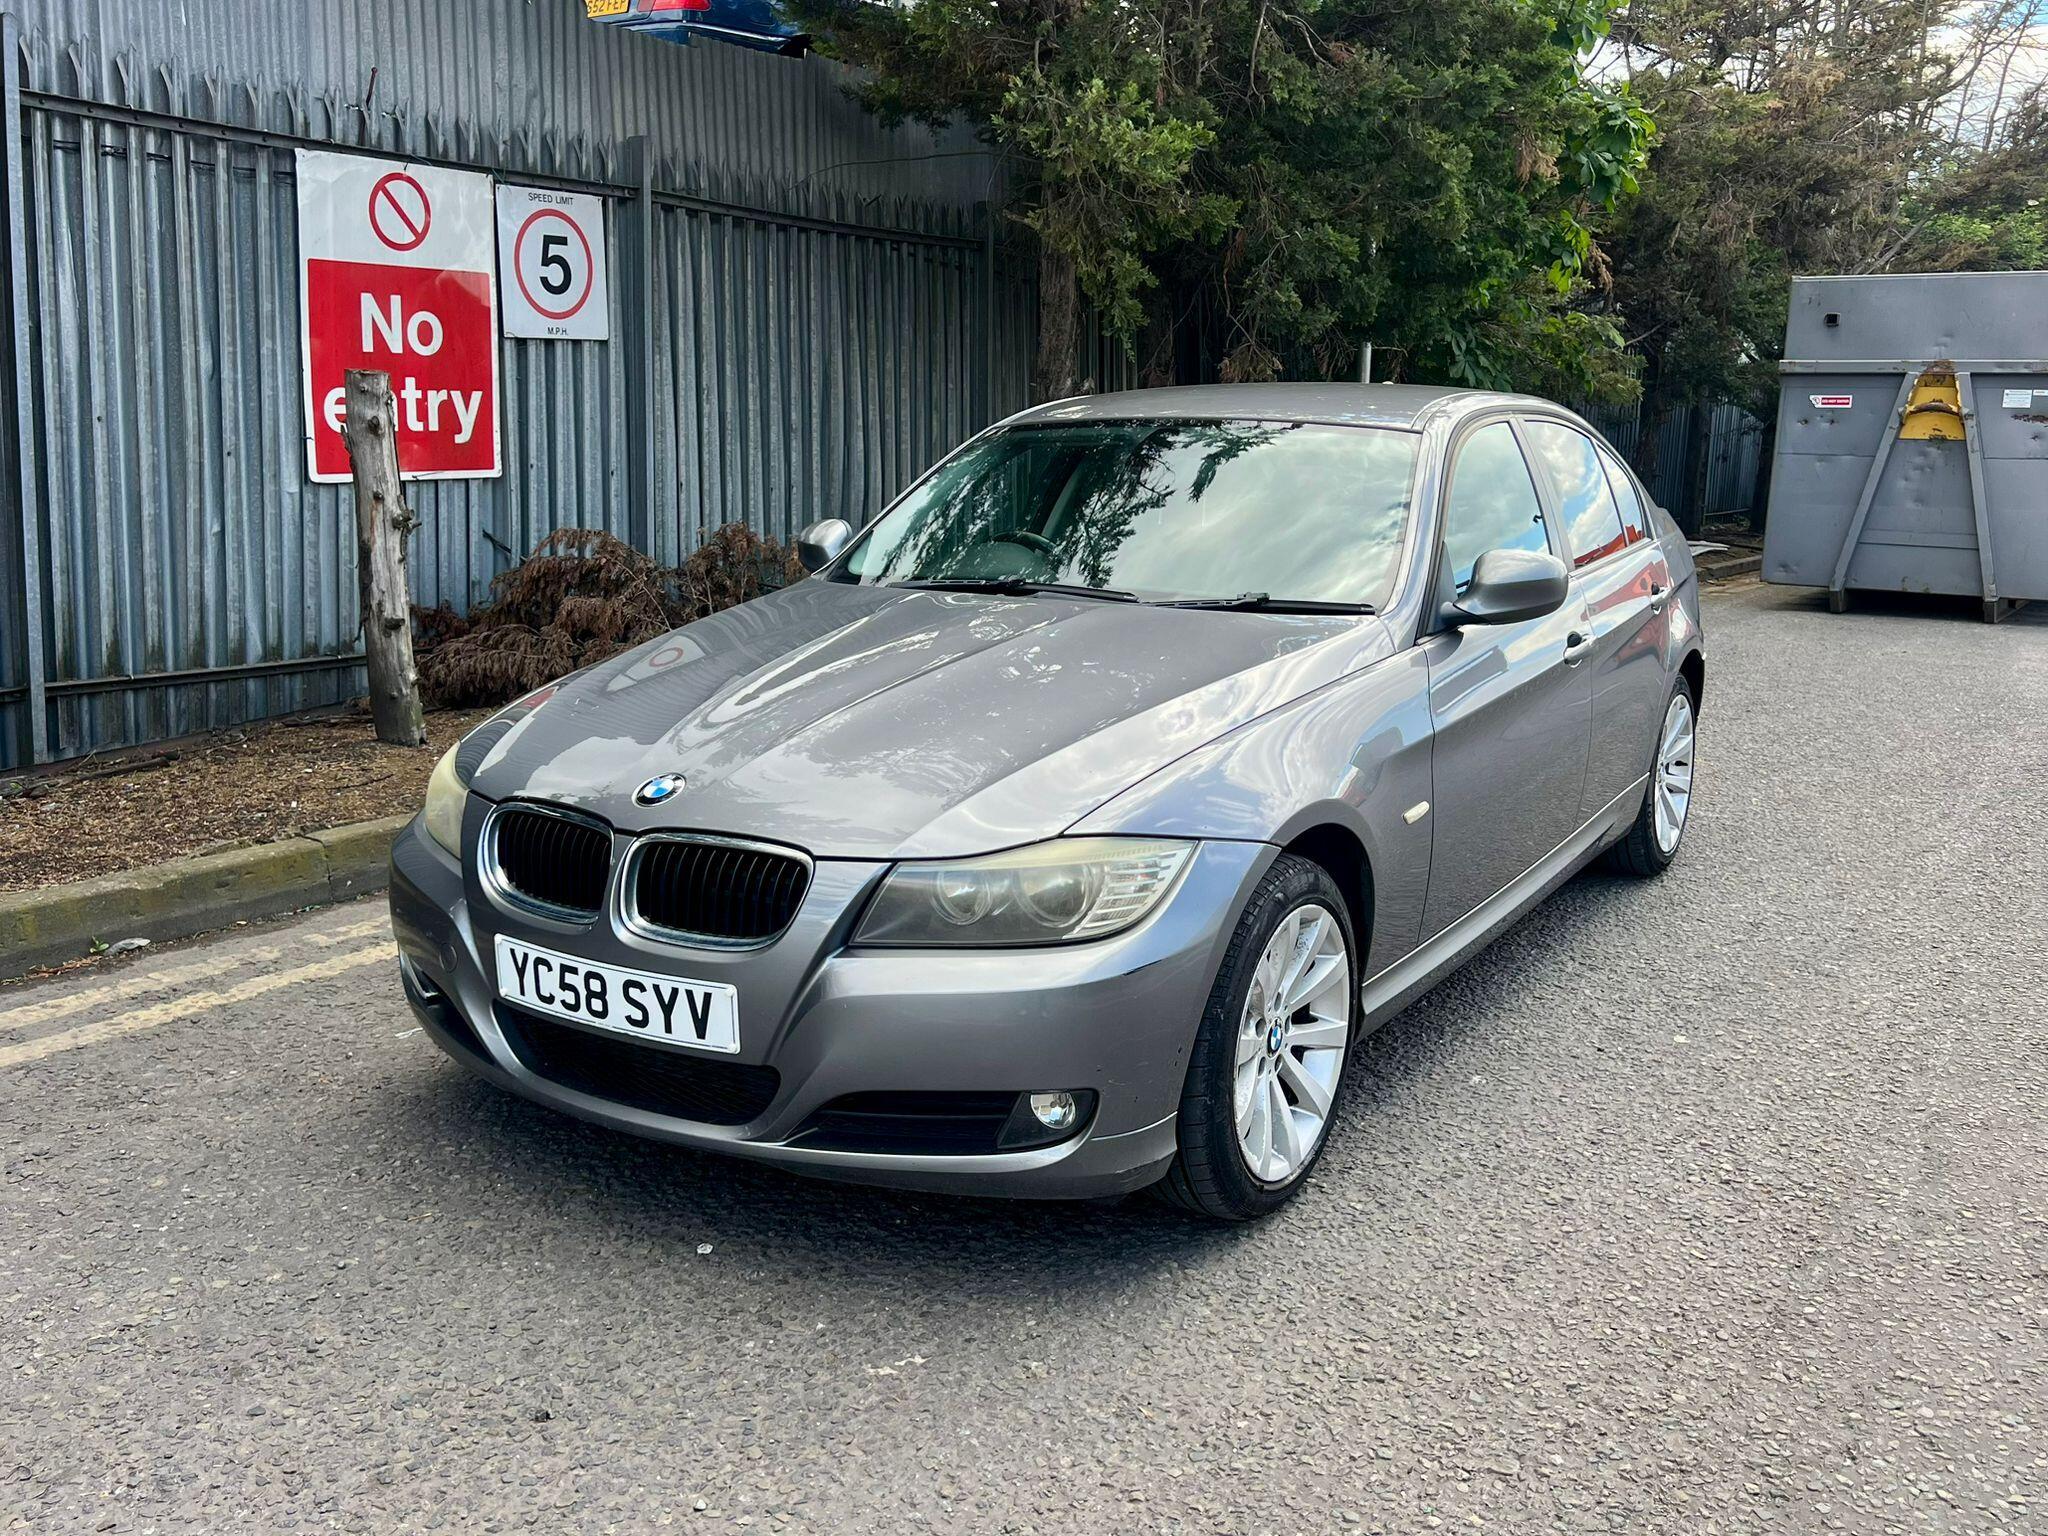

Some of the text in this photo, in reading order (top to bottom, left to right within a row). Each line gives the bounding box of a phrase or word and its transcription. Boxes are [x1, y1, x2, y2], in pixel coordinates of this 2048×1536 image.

[528, 192, 574, 205] SPEED LIMIT
[539, 234, 572, 295] 5
[360, 292, 444, 356] No
[323, 376, 483, 444] etry
[509, 948, 712, 1040] YC58 SYV
